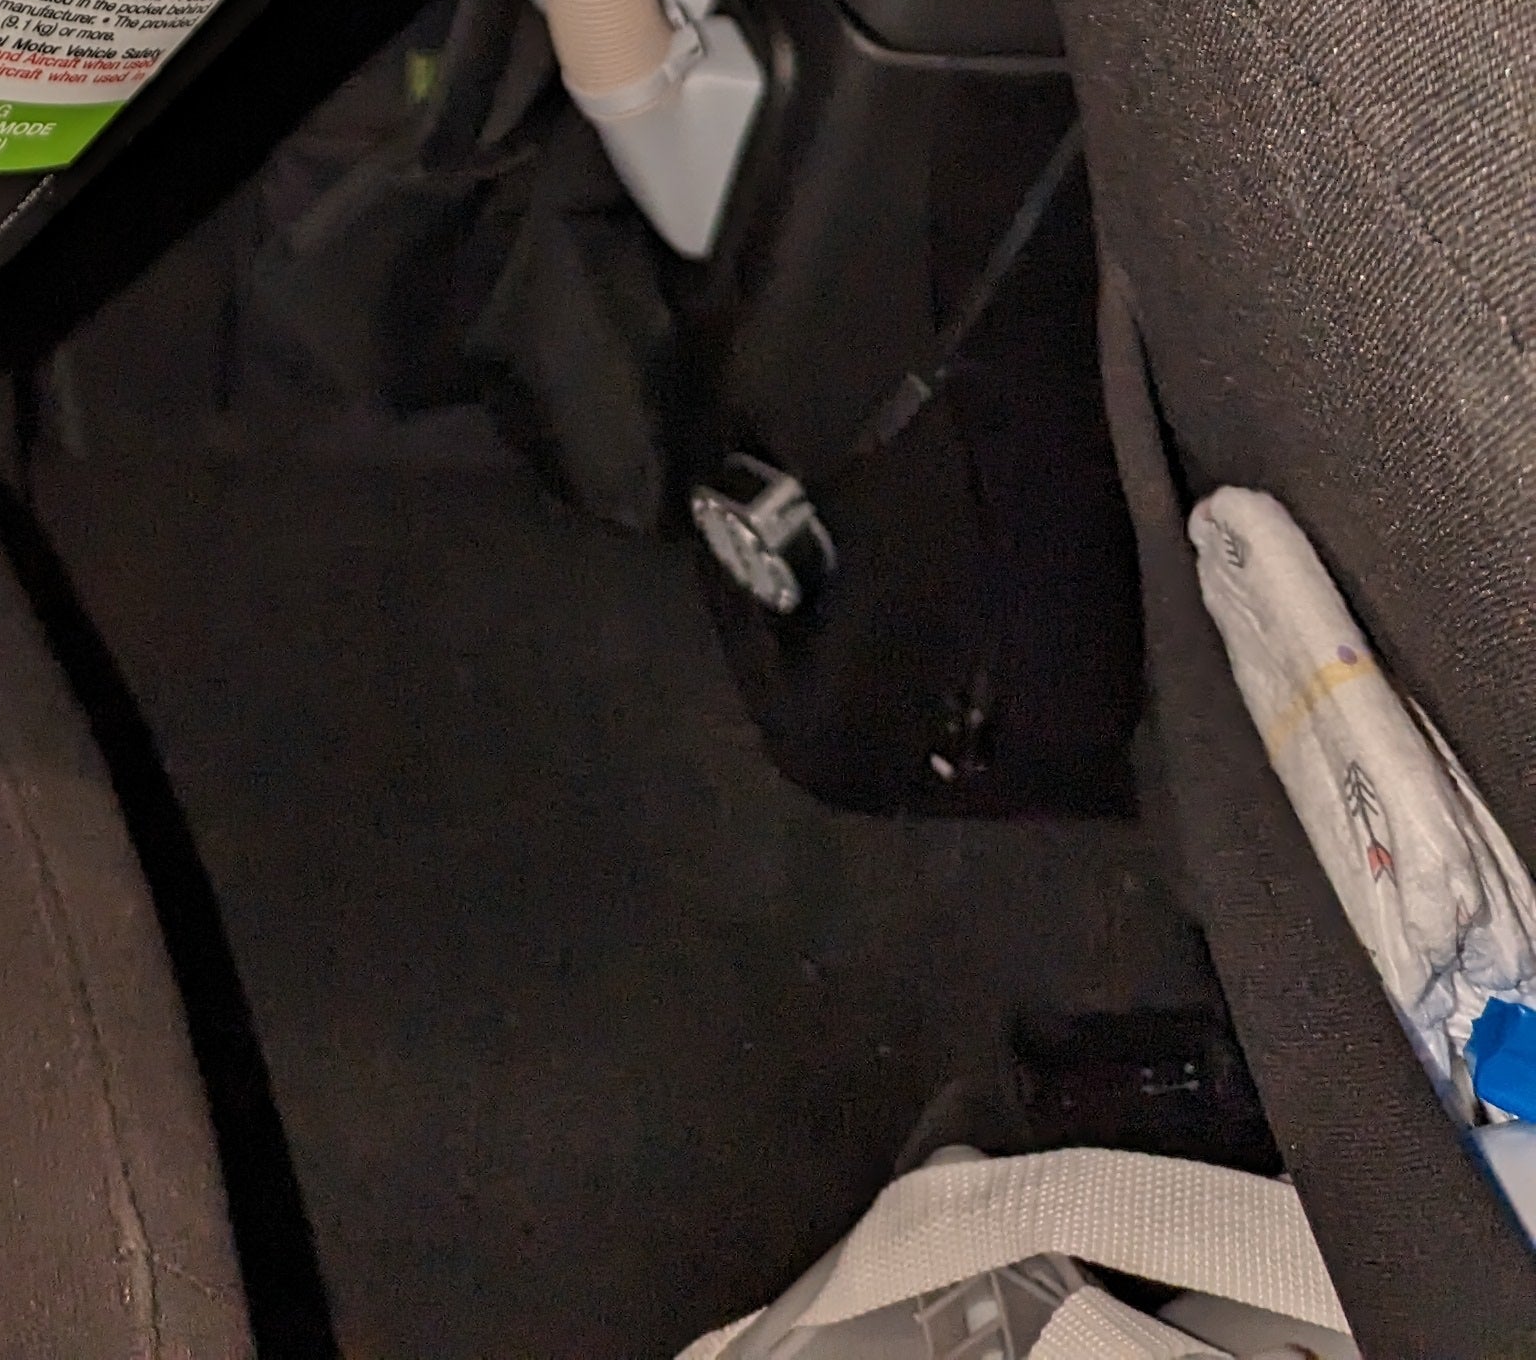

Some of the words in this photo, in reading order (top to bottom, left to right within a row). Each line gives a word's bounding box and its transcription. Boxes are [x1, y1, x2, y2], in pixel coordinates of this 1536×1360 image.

[12, 38, 62, 55] Motor
[66, 45, 117, 59] Vehicle
[121, 48, 165, 60] Safety
